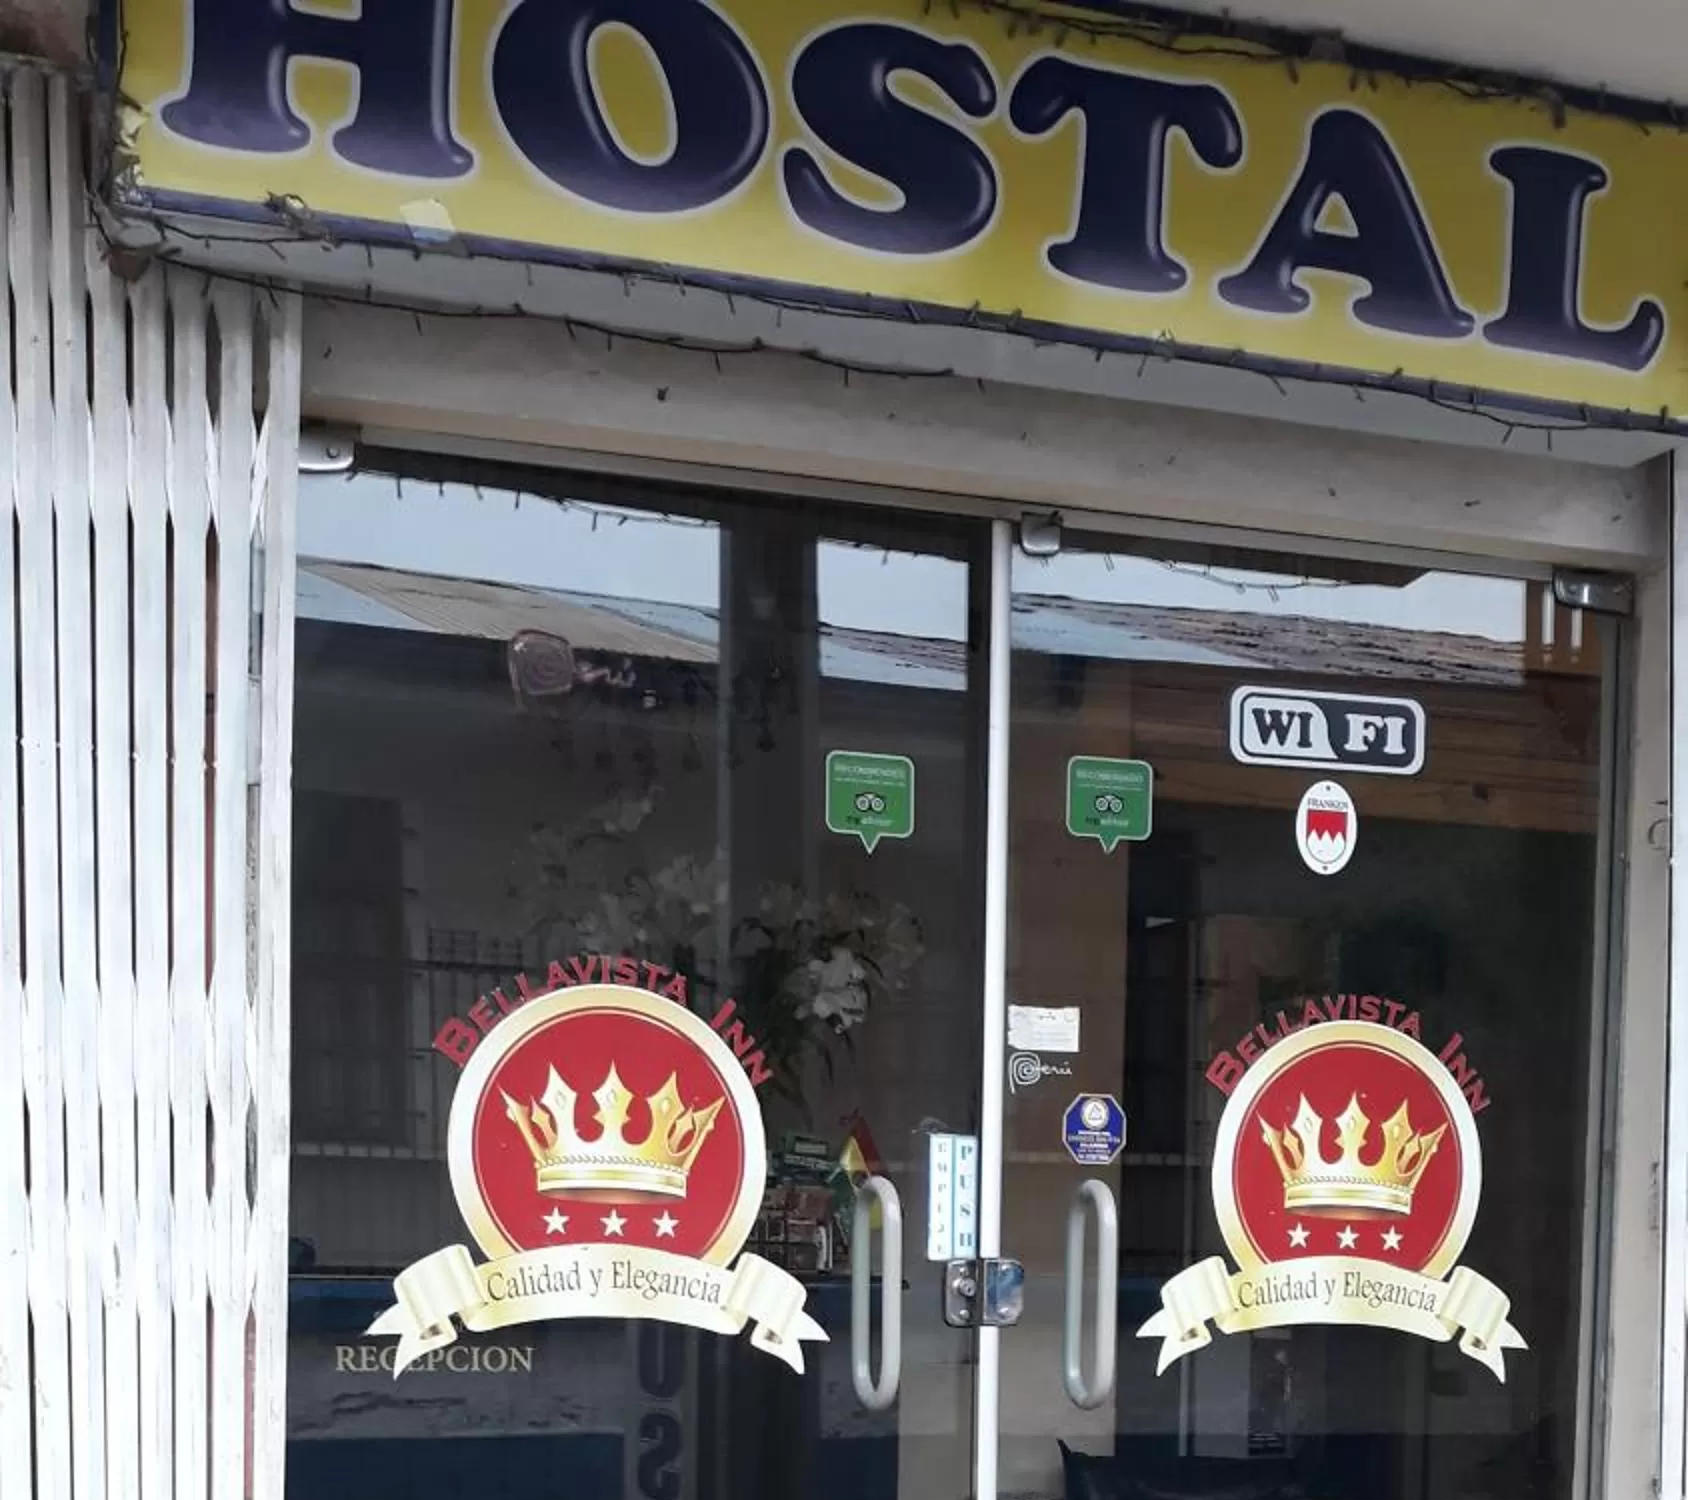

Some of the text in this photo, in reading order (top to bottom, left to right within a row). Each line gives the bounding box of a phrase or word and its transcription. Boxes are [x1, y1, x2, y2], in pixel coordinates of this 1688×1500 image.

[158, 0, 1666, 372] HOSTAL
[1252, 708, 1407, 755] WI FI
[432, 954, 773, 1087] BELLAVISTA INN
[1205, 993, 1491, 1112] BELLAVISTA INN
[960, 1145, 973, 1247] PUSH
[486, 1260, 721, 1304] Calidad y Elegancia
[1238, 1271, 1438, 1313] Calidad y Elegancia
